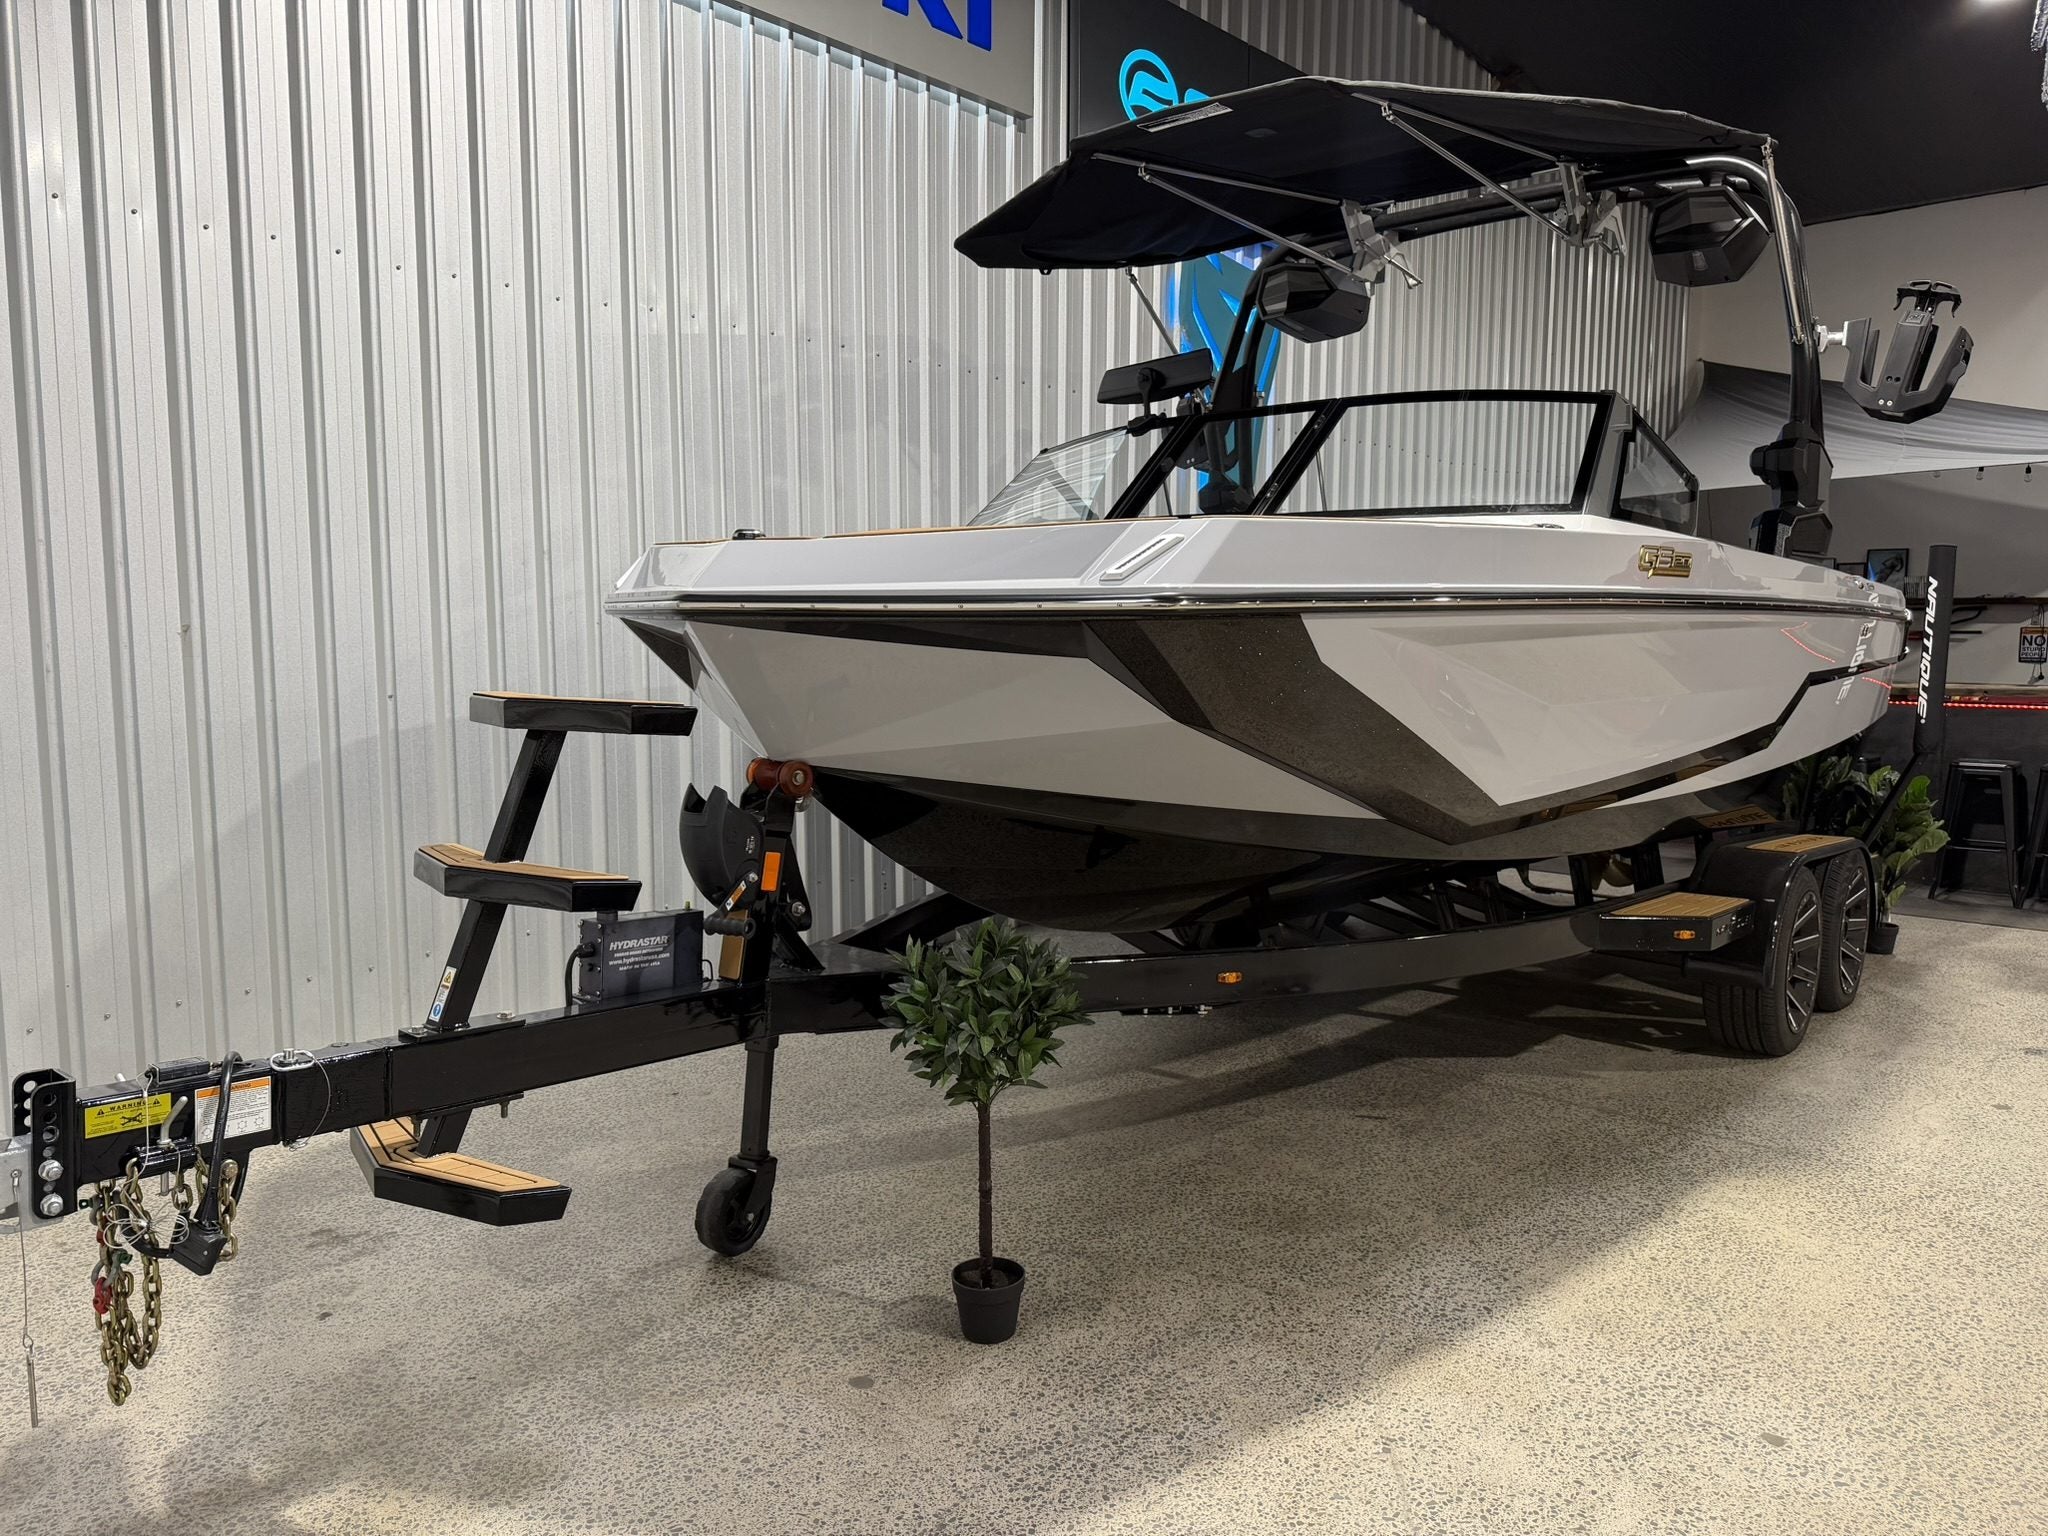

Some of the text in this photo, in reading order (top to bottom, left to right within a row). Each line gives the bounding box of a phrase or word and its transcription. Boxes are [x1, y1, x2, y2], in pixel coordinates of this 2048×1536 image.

[1917, 576, 1938, 719] NAUTIQUE
[2022, 635, 2046, 646] NO
[609, 935, 668, 951] HYDRASTAR
